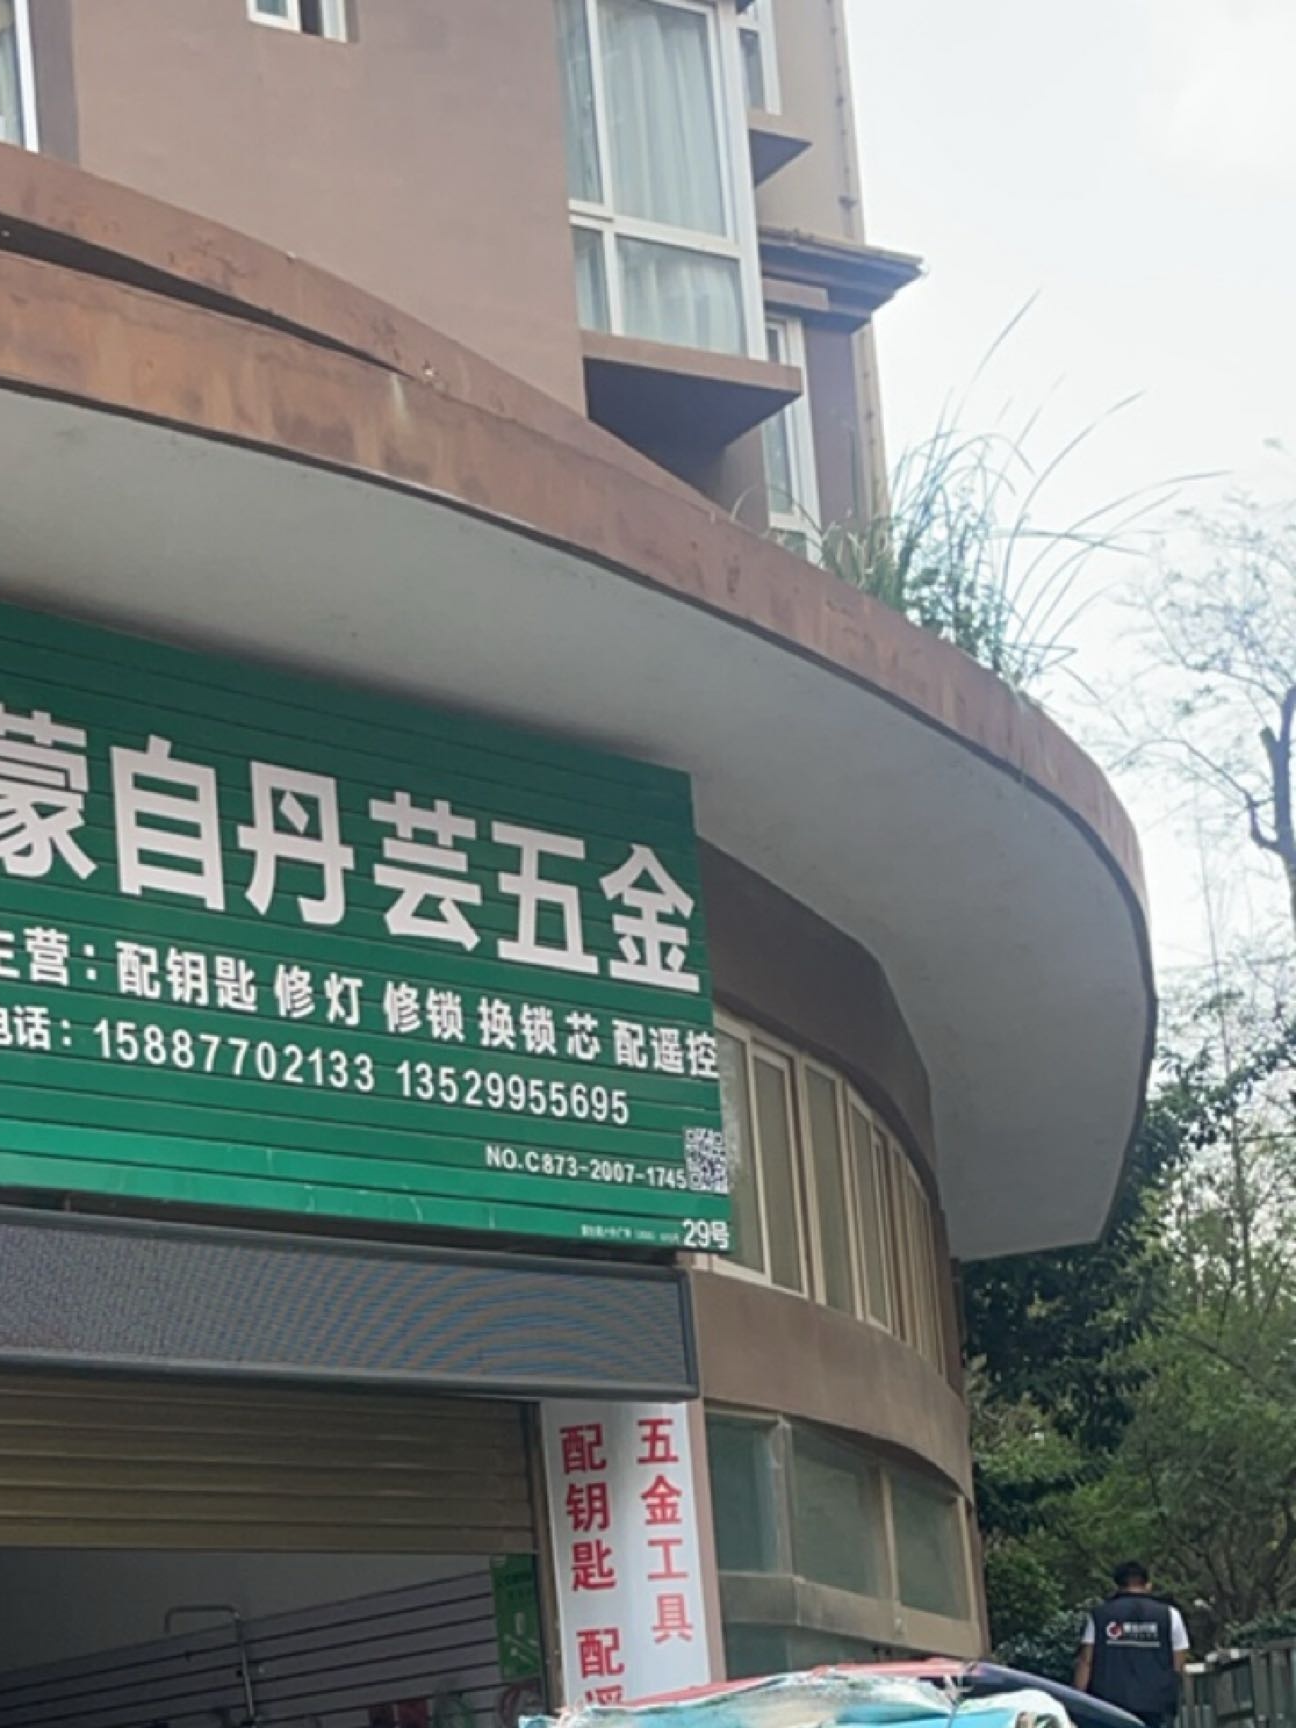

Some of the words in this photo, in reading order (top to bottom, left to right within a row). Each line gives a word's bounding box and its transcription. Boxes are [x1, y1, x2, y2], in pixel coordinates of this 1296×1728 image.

[274, 963, 364, 1026] 修灯
[382, 980, 465, 1043] 修锁
[477, 995, 601, 1061] 换锁芯
[611, 1019, 720, 1079] 配遥控
[395, 1059, 630, 1125] 13529955695
[682, 1218, 730, 1250] 29号
[559, 1422, 617, 1592] 配钥匙
[636, 1417, 693, 1645] 五金工具
